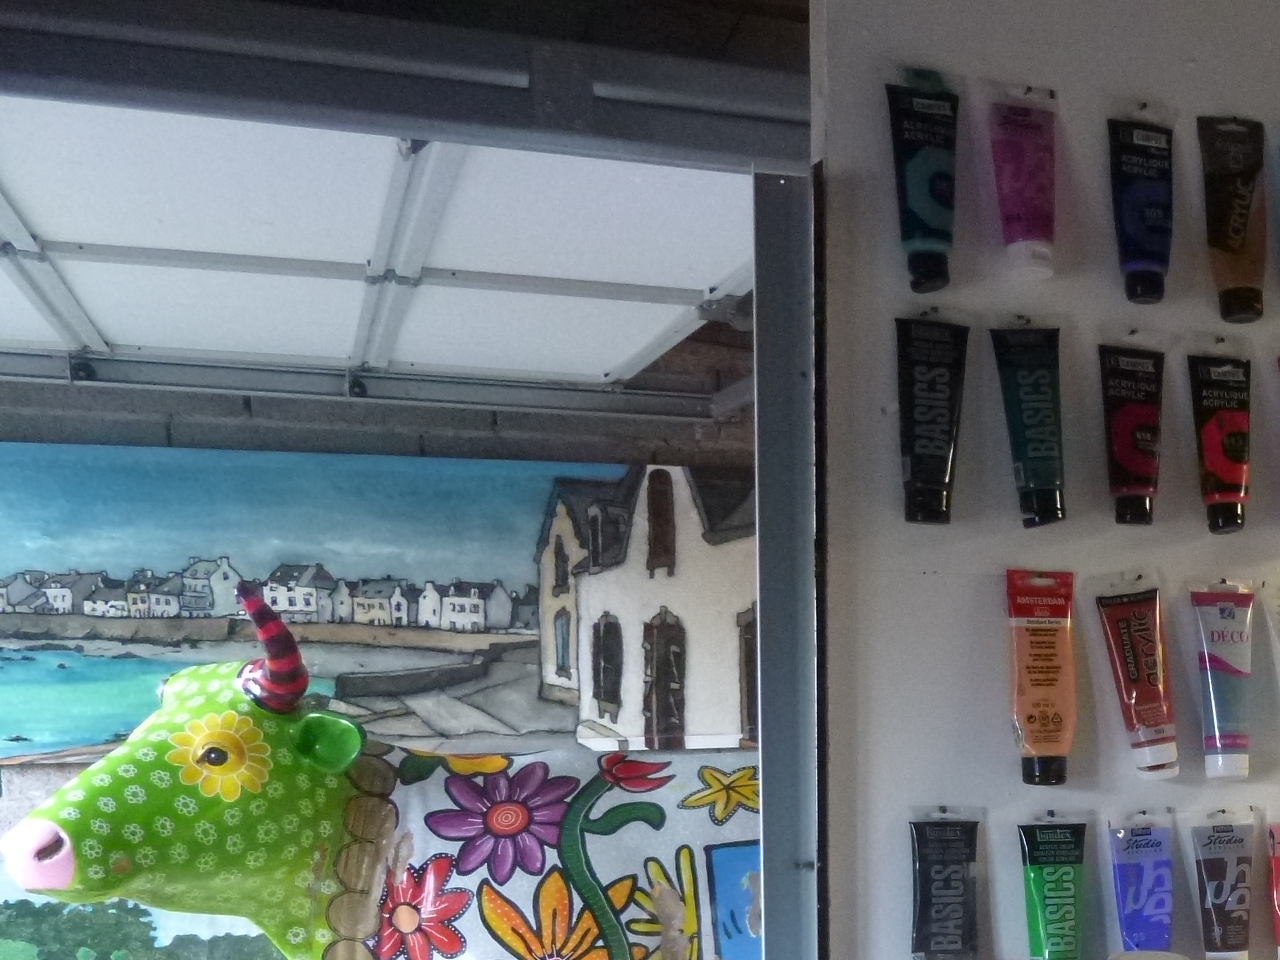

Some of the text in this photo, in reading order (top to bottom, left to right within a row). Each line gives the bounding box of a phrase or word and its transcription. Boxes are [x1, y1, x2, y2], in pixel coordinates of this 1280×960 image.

[1107, 377, 1158, 393] ACRYLIQUE
[1108, 388, 1147, 401] ACRYLIC
[1202, 388, 1249, 400] ACRYLIQUE
[913, 364, 951, 457] BASICS
[1203, 399, 1239, 409] ACRYLIC
[1016, 367, 1061, 459] BASICS
[1016, 596, 1065, 606] AMSTERDAM
[1210, 626, 1249, 643] DÉCO
[1118, 620, 1138, 680] GRADUATE
[1123, 838, 1162, 851] Studio
[1203, 833, 1245, 847] Studio
[930, 864, 964, 951] BASICS
[1043, 865, 1077, 953] BASICS
